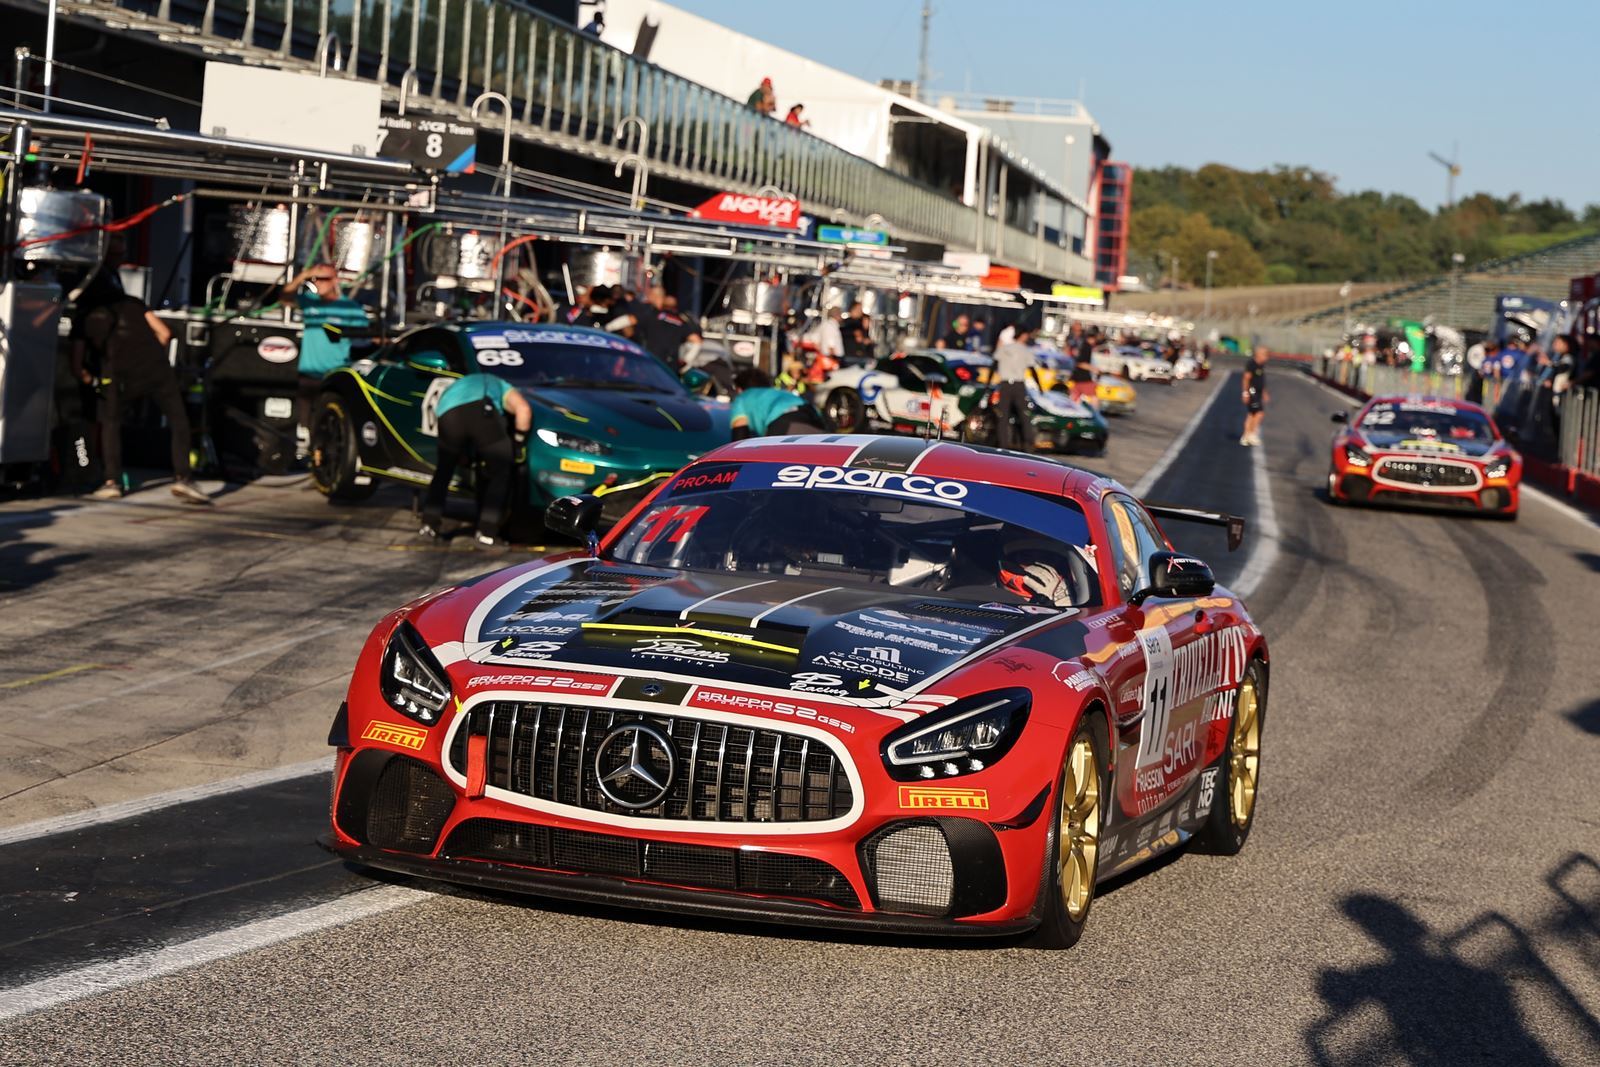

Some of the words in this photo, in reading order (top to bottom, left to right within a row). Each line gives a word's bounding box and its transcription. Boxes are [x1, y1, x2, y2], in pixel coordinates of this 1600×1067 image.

[425, 133, 443, 158] 8
[476, 350, 524, 366] 68
[672, 471, 739, 491] PRO-AM
[771, 465, 969, 506] sparco
[640, 504, 711, 543] 11
[812, 655, 909, 682] ARCODE
[847, 653, 925, 675] CONSULTING
[468, 675, 535, 686] GRUPPO
[531, 676, 574, 688] S2
[789, 682, 850, 697] Racing
[698, 691, 774, 709] GRUPPO
[773, 703, 818, 720] S2
[1146, 676, 1167, 756] 11
[363, 721, 428, 750] PIRELLI
[1164, 719, 1197, 774] SARI
[1201, 769, 1218, 790] TEC
[900, 787, 989, 810] PIRELLI
[1197, 788, 1214, 809] NO
